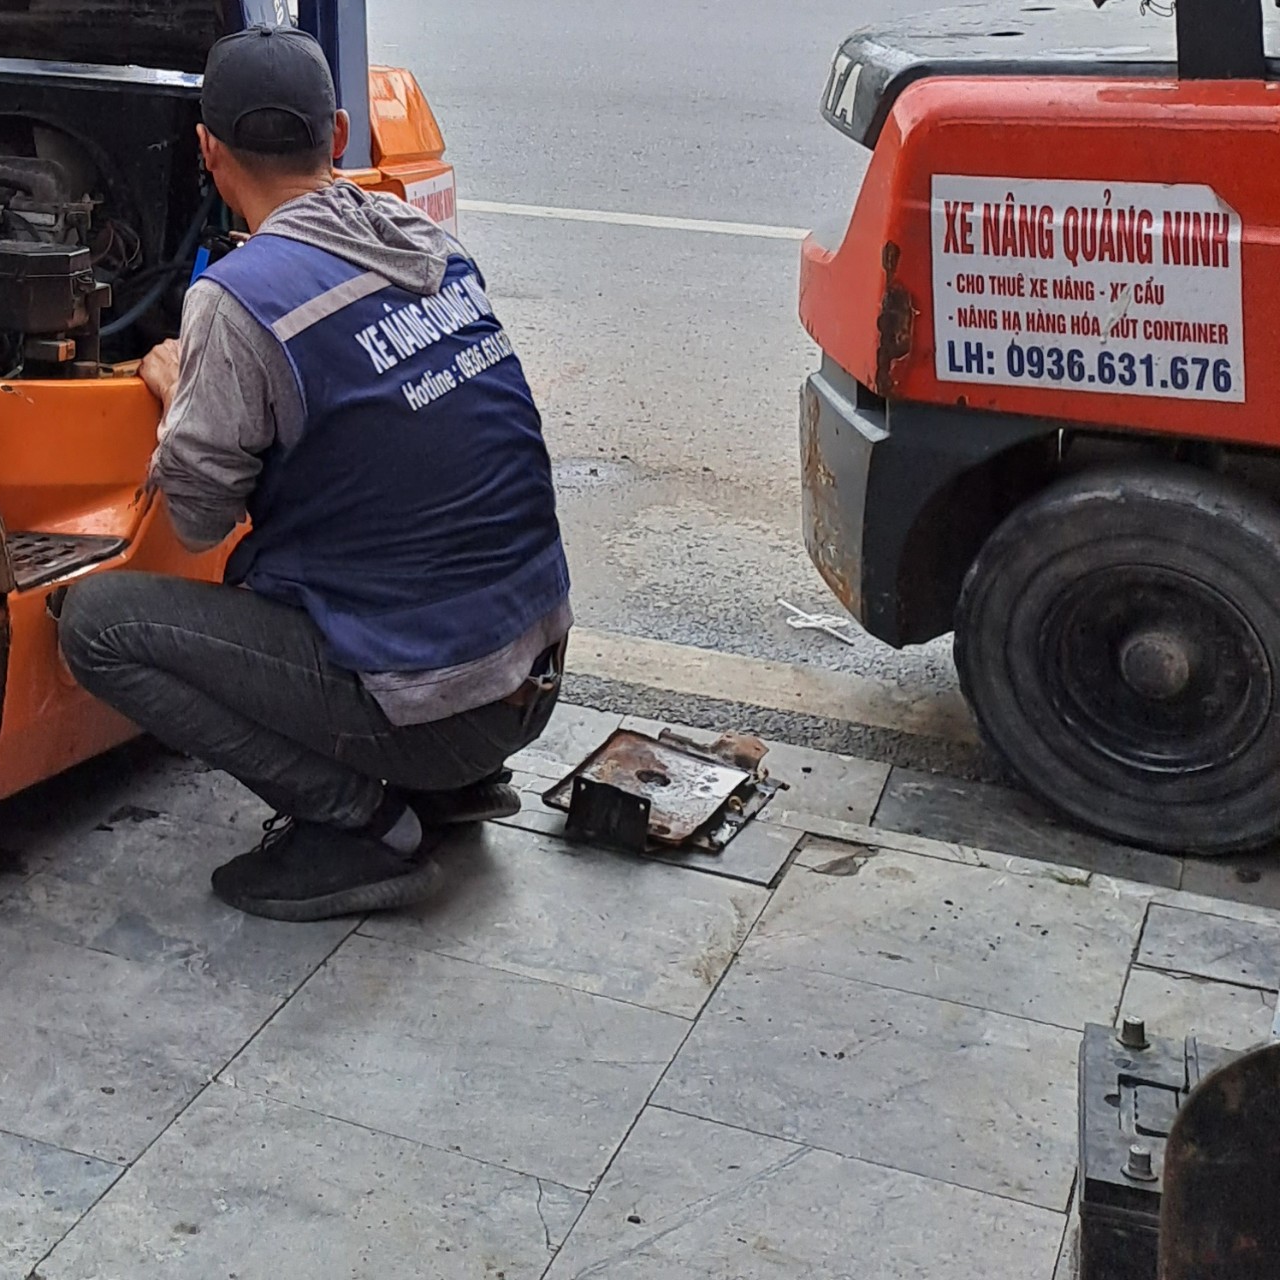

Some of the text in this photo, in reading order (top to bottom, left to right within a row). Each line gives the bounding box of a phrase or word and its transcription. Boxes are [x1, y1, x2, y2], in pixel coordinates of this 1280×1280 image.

[826, 52, 864, 127] TA
[943, 188, 1230, 268] XE NÂNG QUẢNG NINH
[956, 273, 985, 295] CHO
[988, 272, 1025, 298] THUÊ
[1029, 278, 1048, 299] XE
[1052, 276, 1095, 302] NÂNG
[1134, 275, 1165, 306] CẨU
[354, 324, 398, 374] XE
[378, 302, 441, 360] NÂNG
[957, 305, 997, 329] NÂNG
[1001, 311, 1022, 338] HẠ
[1025, 308, 1067, 334] HÀNG
[1142, 319, 1229, 345] CONTAINER
[401, 370, 457, 412] Hotline
[947, 340, 1233, 393] LH: 0936.631.676
